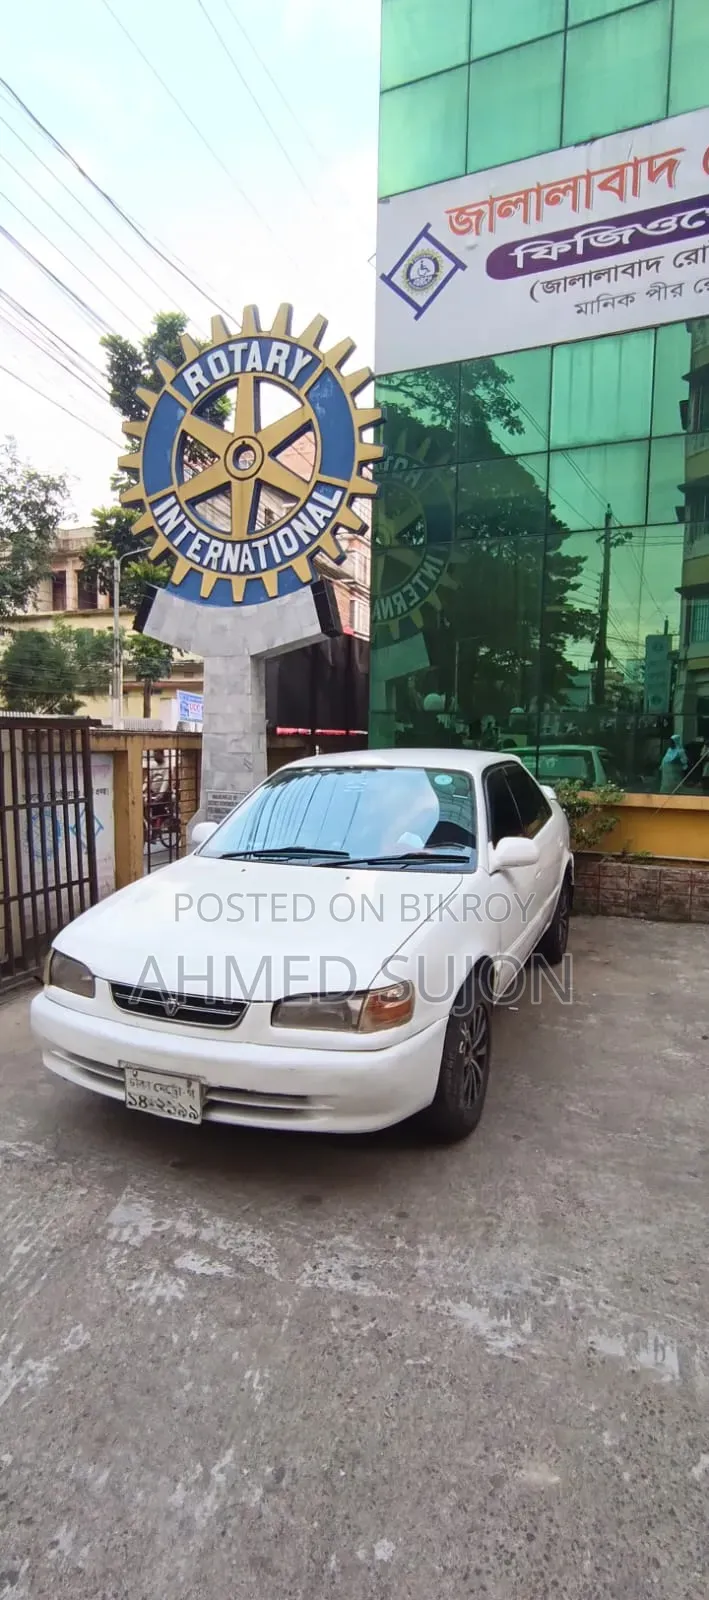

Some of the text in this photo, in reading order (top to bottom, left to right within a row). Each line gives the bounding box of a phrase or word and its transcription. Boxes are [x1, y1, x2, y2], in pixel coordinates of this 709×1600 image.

[445, 147, 687, 237] জালালাবাদ
[529, 255, 665, 304] (জালালাবাদ
[574, 291, 637, 316] মানিক
[645, 281, 685, 302] পীর
[182, 340, 313, 398] ROTARY
[152, 488, 343, 574] INTERNATIONAL
